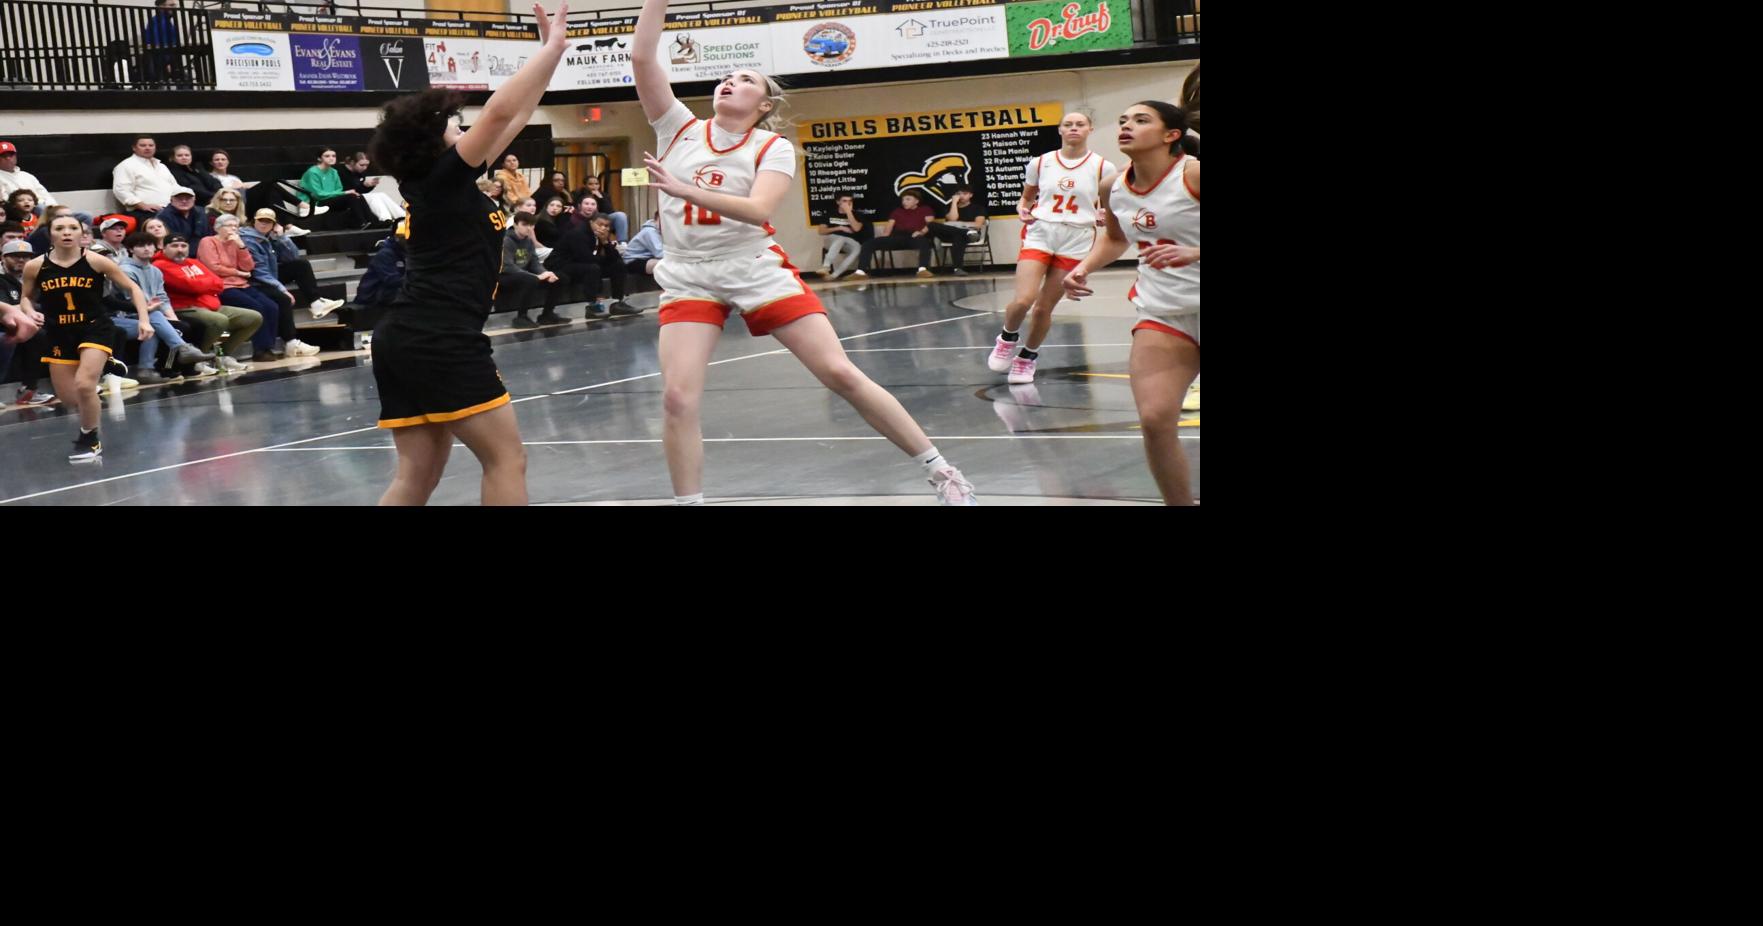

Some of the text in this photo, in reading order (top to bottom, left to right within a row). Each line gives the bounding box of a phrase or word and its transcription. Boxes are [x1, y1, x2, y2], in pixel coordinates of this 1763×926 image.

[892, 0, 996, 12] PIONEER VOLLEYBALL
[702, 11, 735, 19] Sponsor
[776, 5, 878, 20] PIONEER VOLLEYBALL
[664, 16, 761, 29] PIONEER VOLLEYBALL
[930, 16, 996, 28] TruePoint
[1027, 3, 1111, 50] Dr. Enuf
[703, 43, 760, 53] SPEED GOAT
[567, 55, 597, 67] MAUK
[703, 51, 754, 61] SOLUTIONS
[891, 52, 931, 60] Specializing
[226, 59, 281, 68] PRECISION POOLS
[694, 63, 731, 72] Inspection
[383, 59, 404, 89] V
[811, 107, 1043, 138] GIRLS BASKETBALL
[991, 131, 1018, 139] Hannah
[992, 140, 1017, 148] Maison
[994, 157, 1013, 165] Rylee
[847, 168, 868, 176] Haney
[841, 184, 867, 192] Howard
[1052, 194, 1078, 214] 24
[41, 276, 94, 291] SCIENCE
[64, 292, 75, 310] 1
